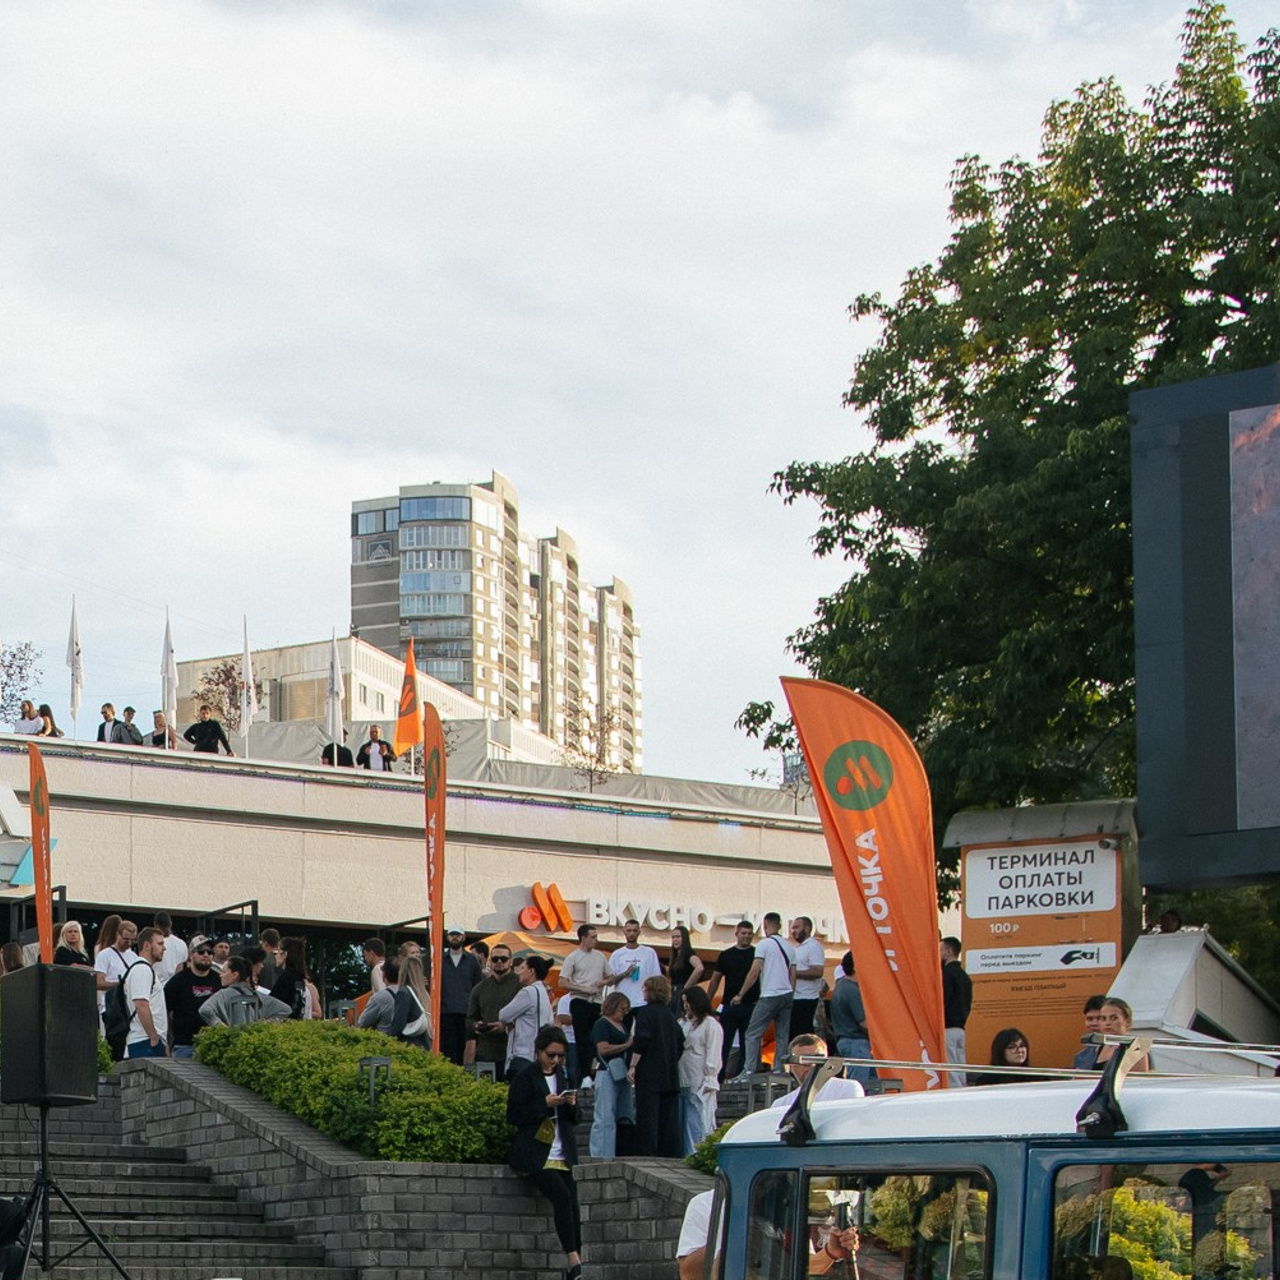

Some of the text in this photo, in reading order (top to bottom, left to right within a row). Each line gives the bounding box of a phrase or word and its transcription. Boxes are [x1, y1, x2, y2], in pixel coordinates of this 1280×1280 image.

[987, 850, 1095, 870] ТЕРМИНАЛ
[999, 871, 1083, 889] ОПЛАТЫ
[988, 891, 1094, 911] ПАРКОВКИ
[587, 898, 713, 933] ВКУСНО
[989, 922, 1011, 934] 100
